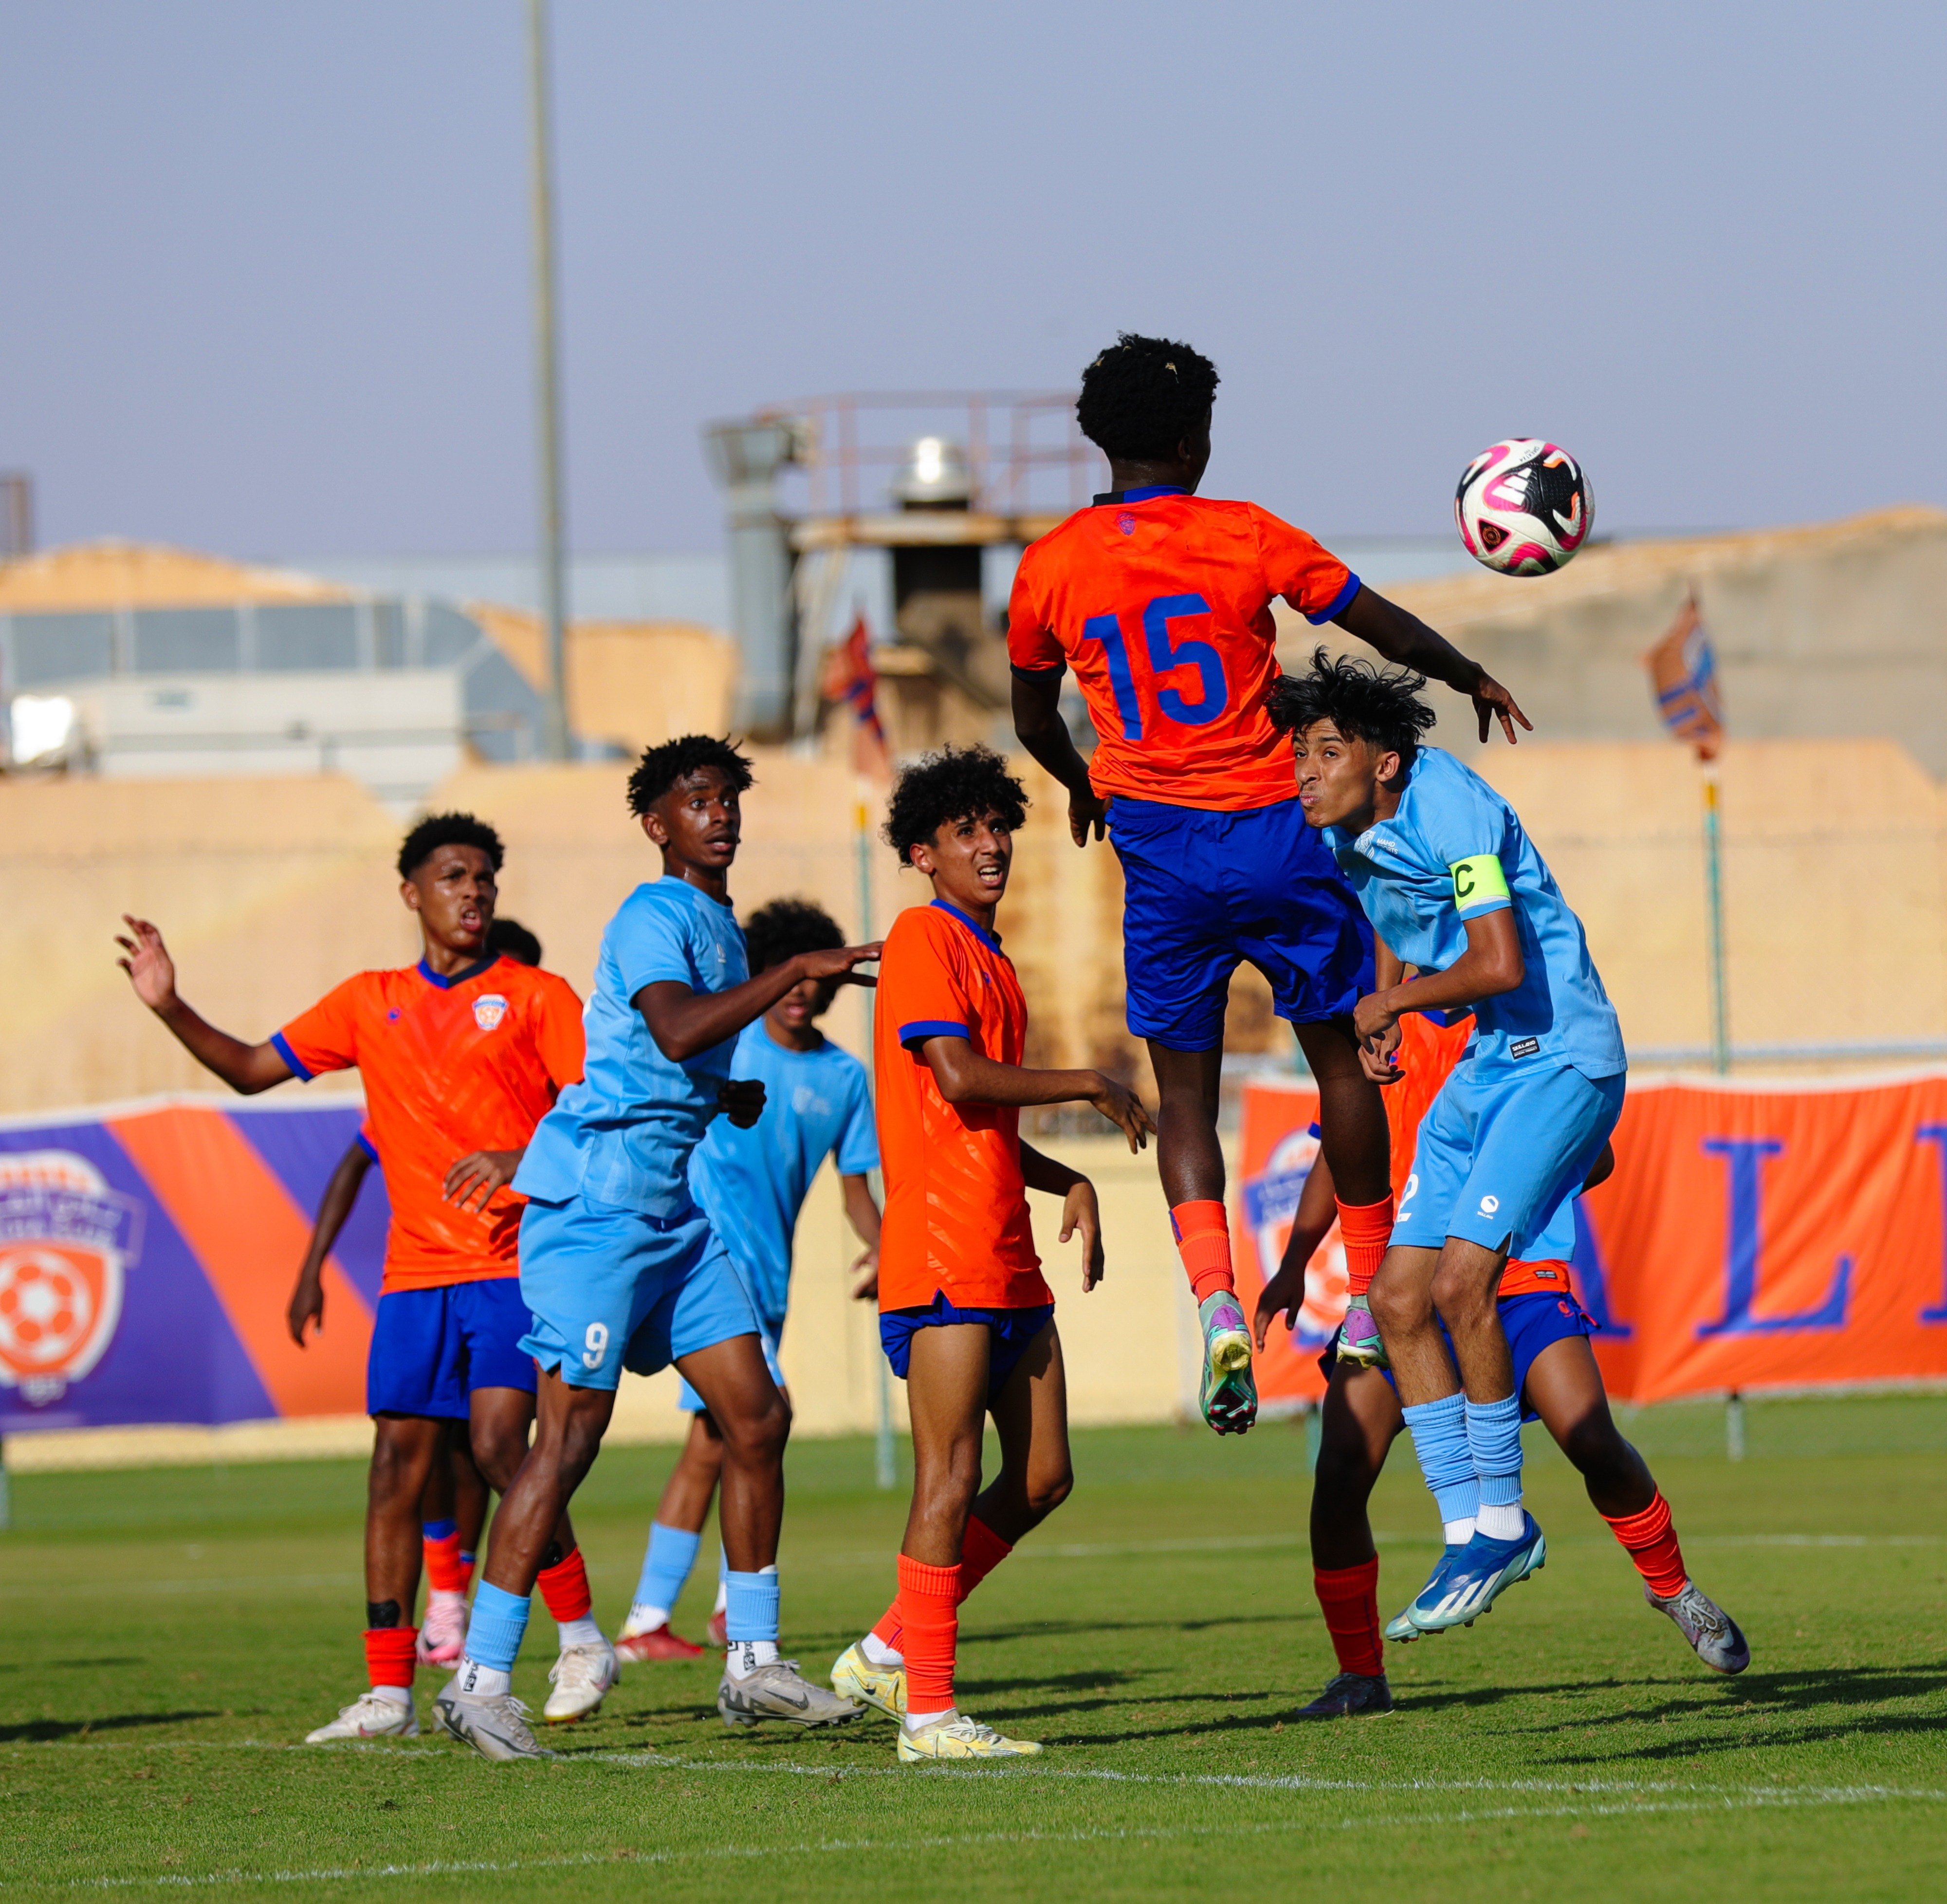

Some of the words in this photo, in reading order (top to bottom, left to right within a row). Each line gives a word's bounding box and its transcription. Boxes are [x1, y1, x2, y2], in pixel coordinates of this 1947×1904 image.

[1083, 592, 1228, 740] 15
[1377, 838, 1396, 847] MAHD
[1455, 864, 1475, 898] C
[583, 1322, 608, 1369] 9
